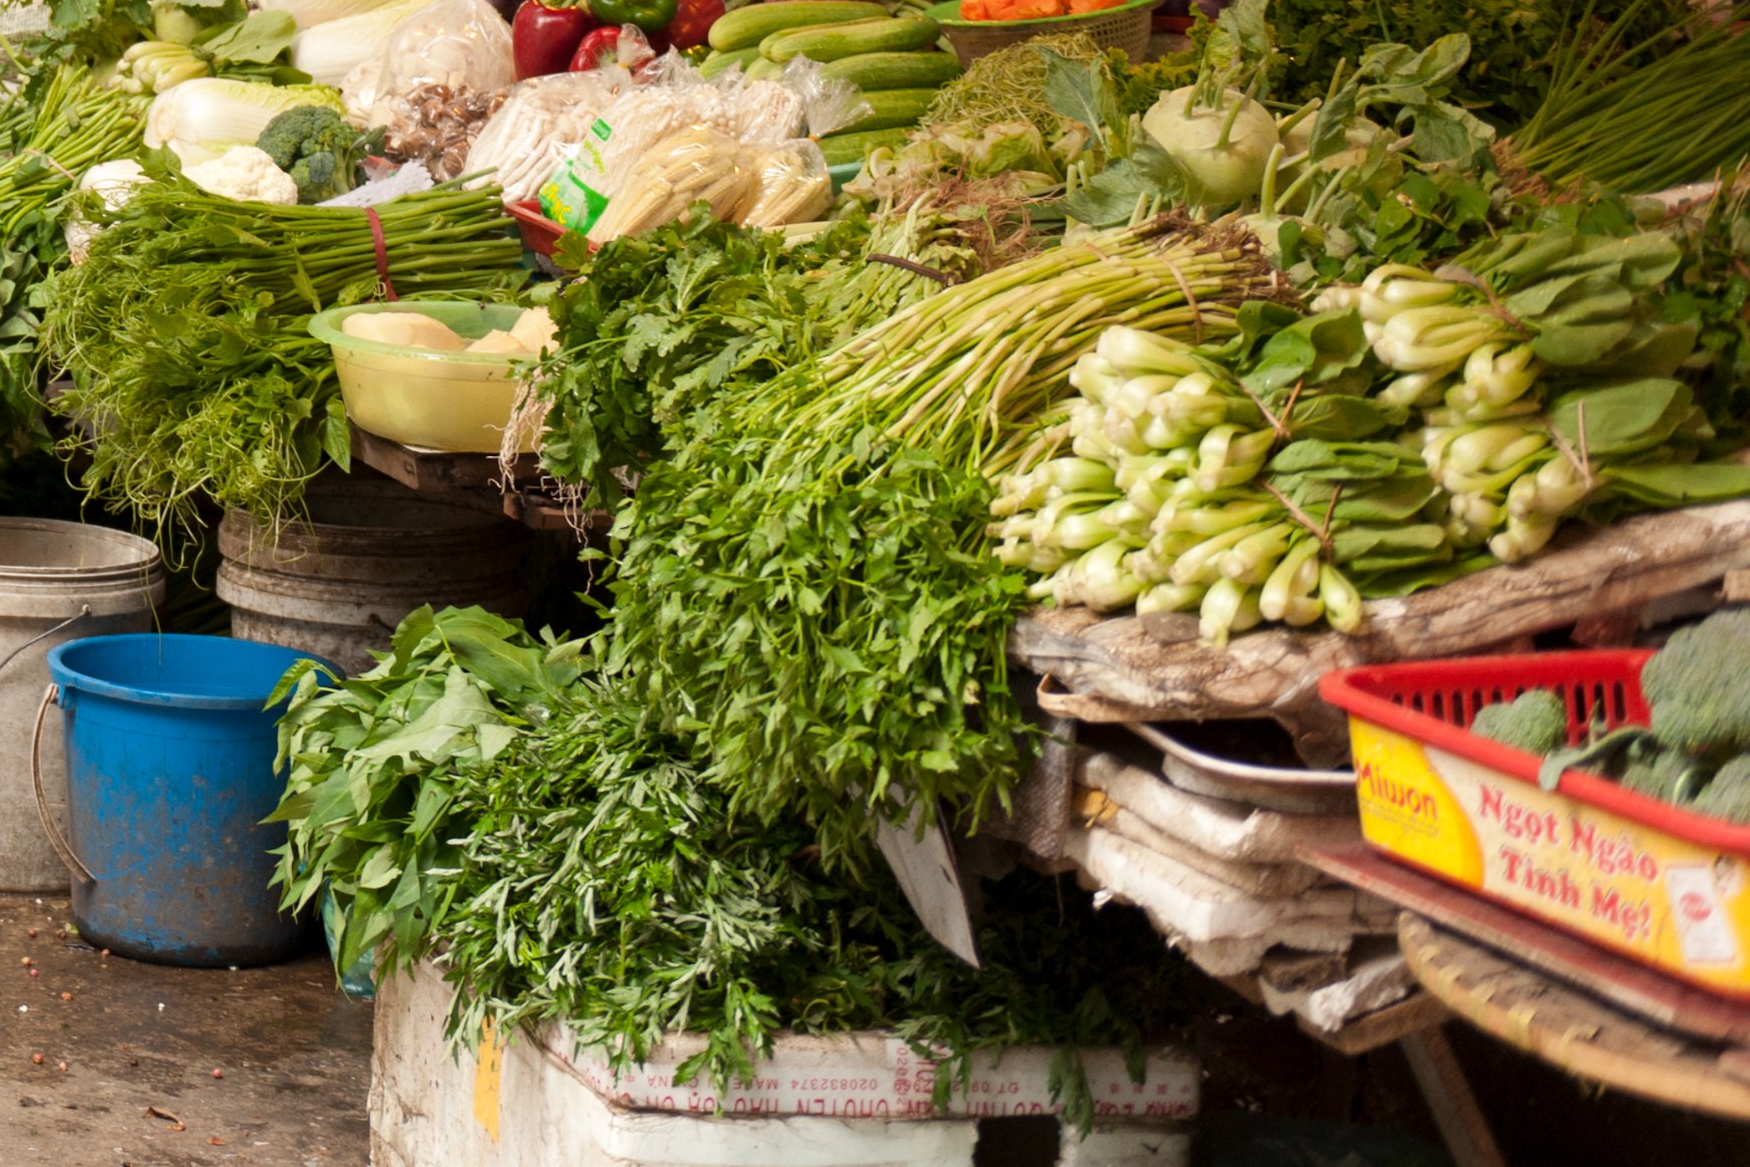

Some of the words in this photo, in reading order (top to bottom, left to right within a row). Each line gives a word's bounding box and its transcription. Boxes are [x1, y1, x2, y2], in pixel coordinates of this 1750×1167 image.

[1355, 757, 1439, 823] Miwon
[1479, 784, 1559, 845] Ngọt
[1570, 819, 1658, 882] Ngào
[1500, 847, 1581, 909] Tình
[1592, 882, 1652, 941] Mẹ!
[790, 1076, 878, 1091] 020832374
